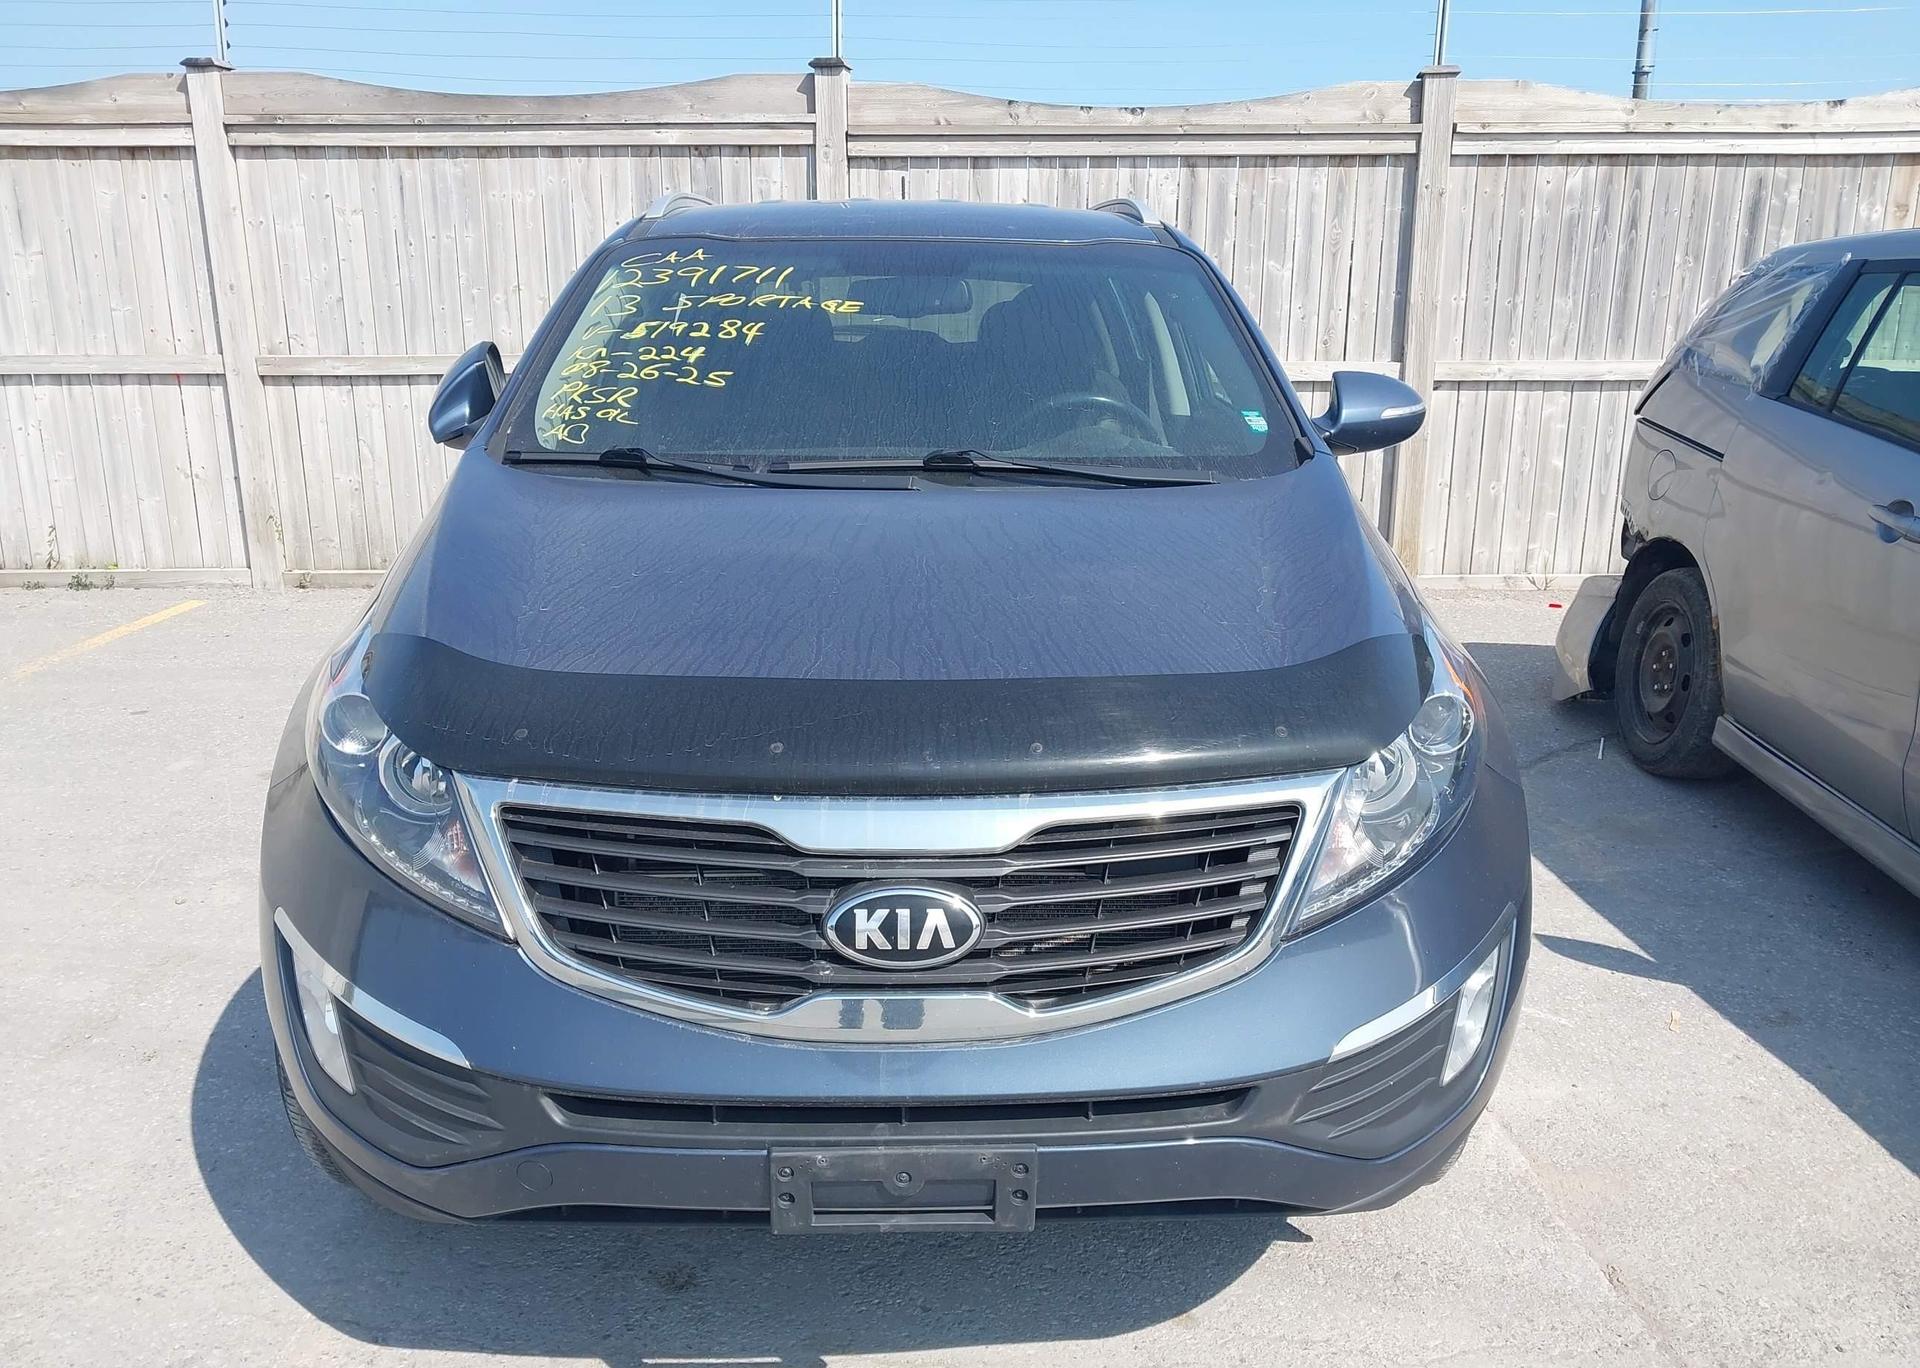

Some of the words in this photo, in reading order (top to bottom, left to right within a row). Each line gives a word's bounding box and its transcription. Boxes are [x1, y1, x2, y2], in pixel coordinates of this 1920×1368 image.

[620, 247, 712, 268] CAA
[595, 265, 794, 295] 12391711
[590, 294, 641, 317] 13
[662, 292, 865, 313] SPORTAGE
[853, 908, 956, 950] KIA
